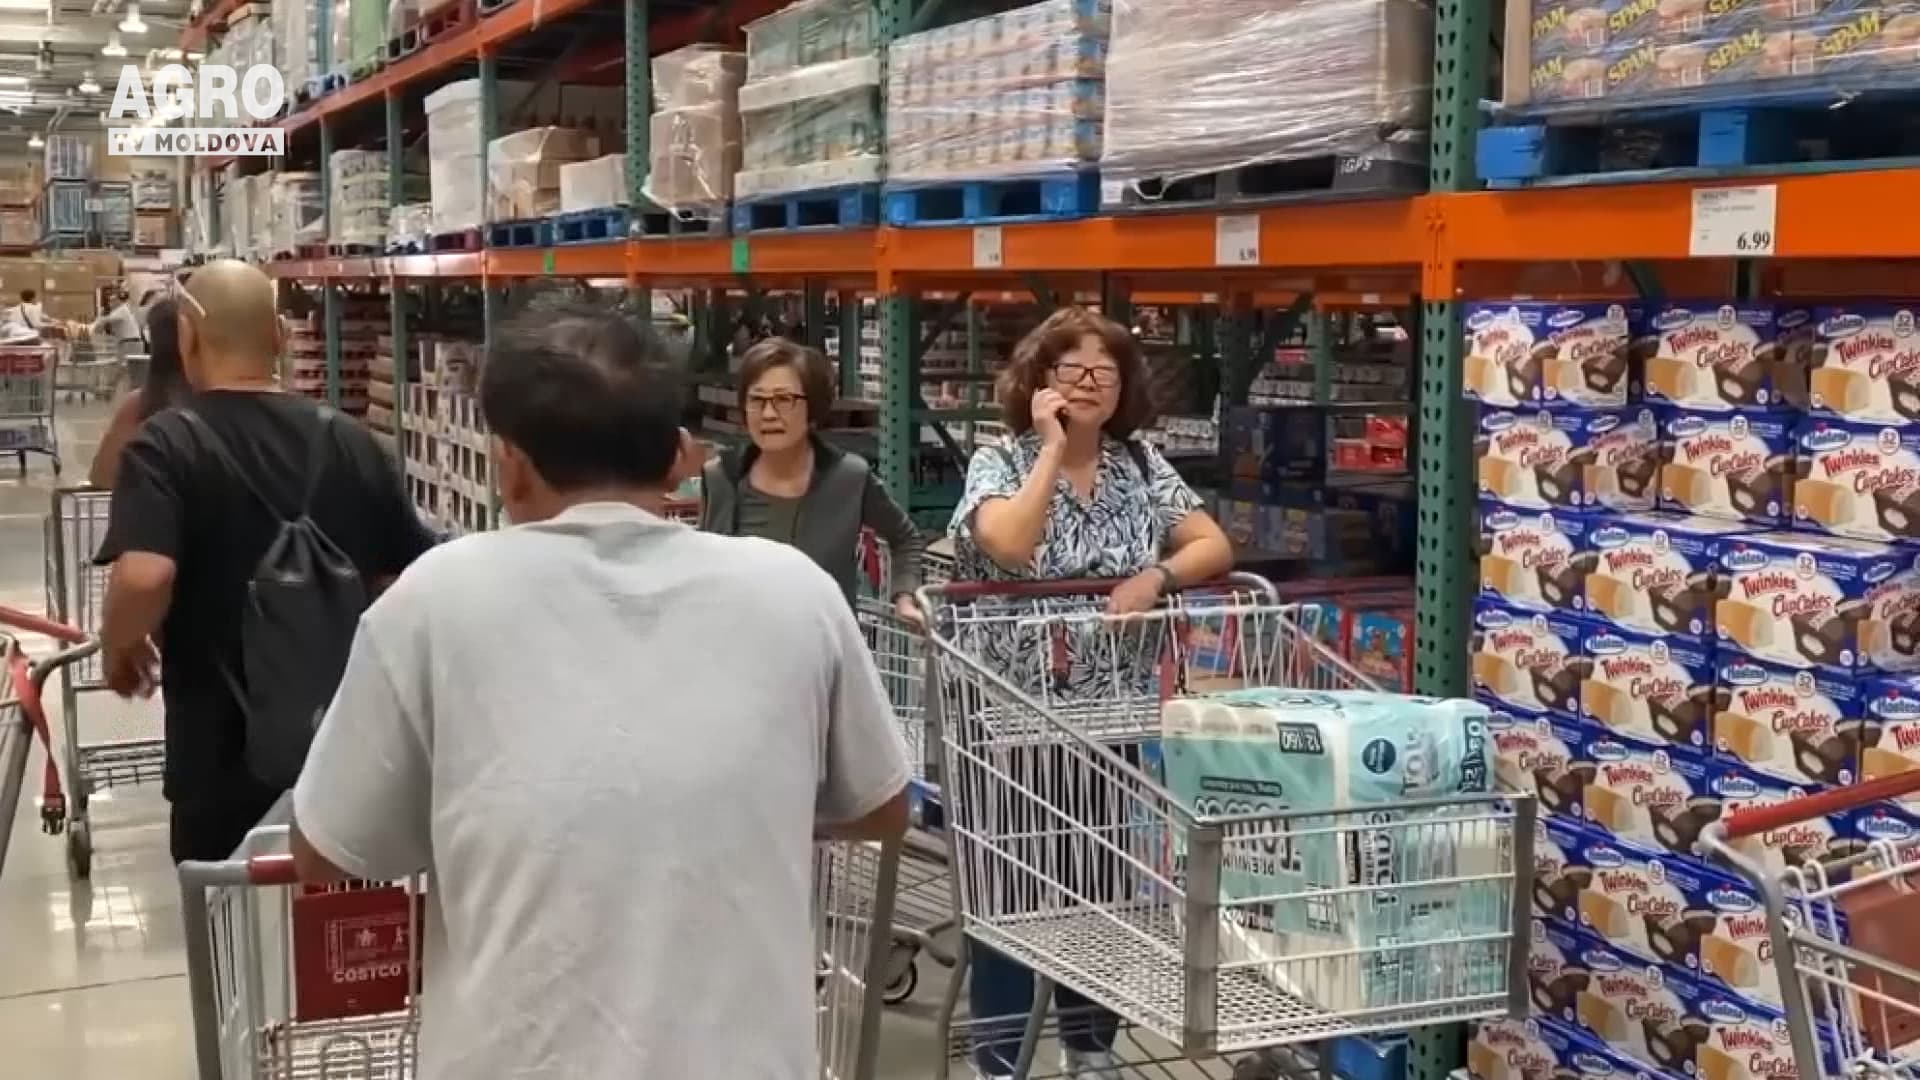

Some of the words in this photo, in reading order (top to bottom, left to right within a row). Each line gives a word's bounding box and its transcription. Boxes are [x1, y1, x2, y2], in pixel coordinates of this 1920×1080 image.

[1608, 0, 1656, 30] SPAM
[1823, 10, 1881, 53] SPAM
[1607, 42, 1656, 80] SPAM
[1708, 29, 1762, 68] SPAM
[1737, 231, 1771, 250] 6.99
[1834, 332, 1893, 363] Twinkies
[1820, 449, 1880, 477] Twinkies
[1854, 468, 1915, 495] CupCakes
[1739, 572, 1798, 598] Twinkies
[1771, 592, 1832, 618] CupCakes
[1602, 657, 1652, 680] Twinkies
[1738, 688, 1797, 713] Twinkies
[1771, 709, 1831, 734] CupCakes
[1763, 825, 1822, 850] CupCakes
[1598, 870, 1647, 893] Twinkies
[333, 965, 401, 983] COSTCO
[1717, 1027, 1772, 1050] Twinkies
